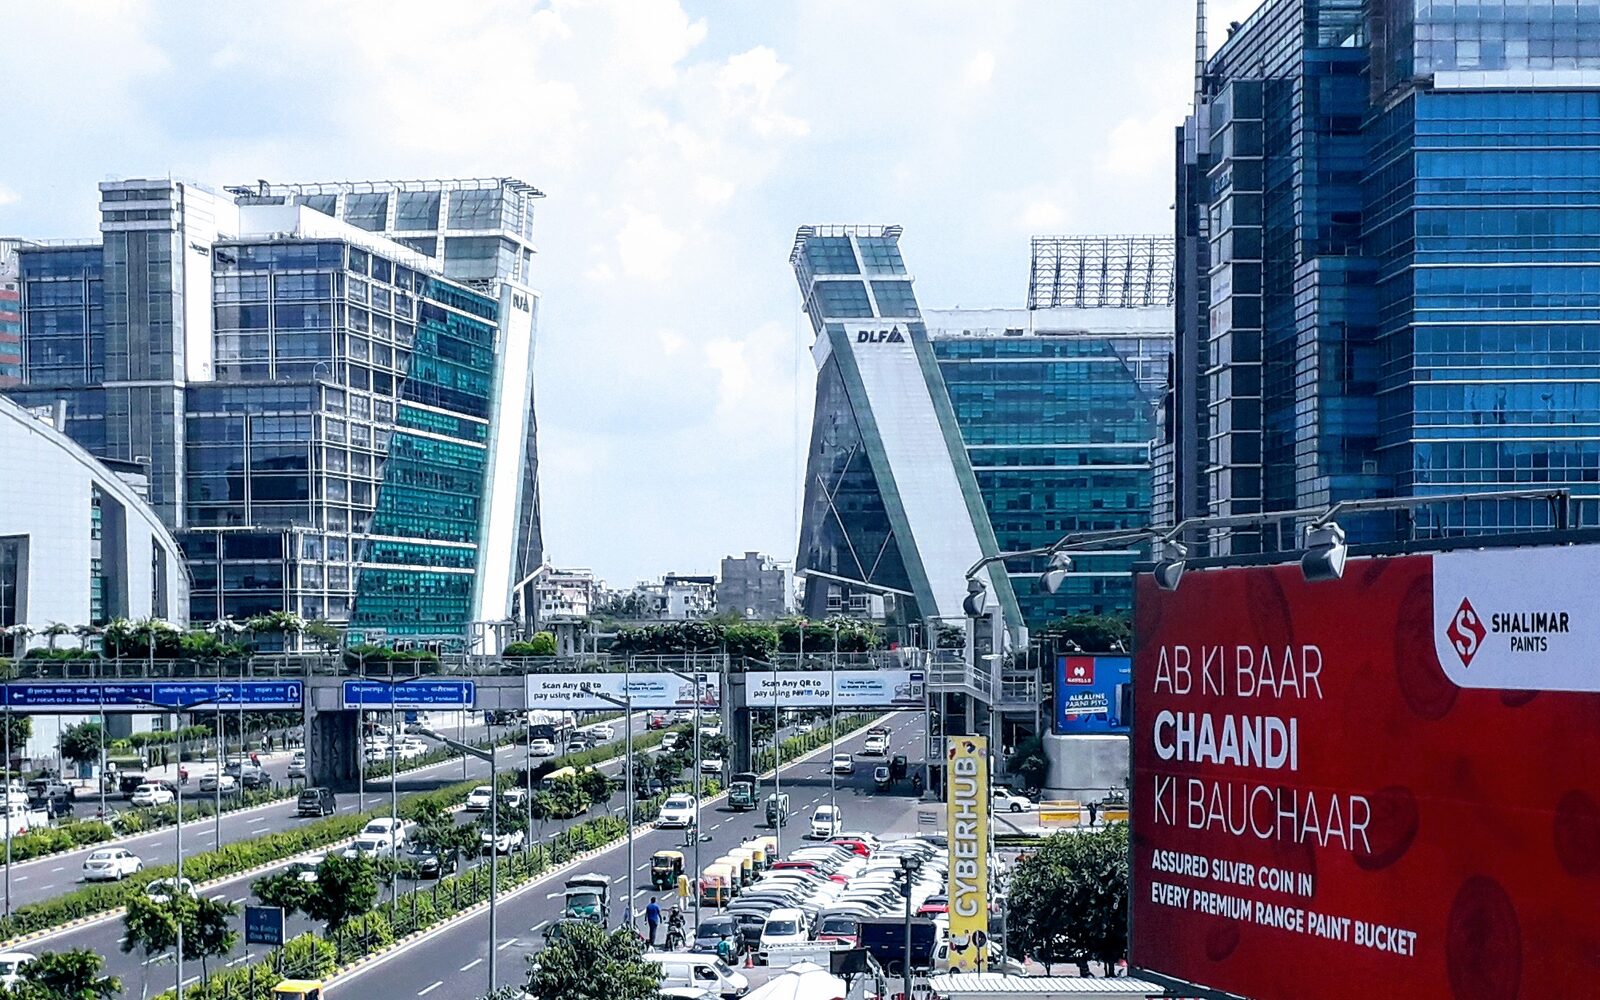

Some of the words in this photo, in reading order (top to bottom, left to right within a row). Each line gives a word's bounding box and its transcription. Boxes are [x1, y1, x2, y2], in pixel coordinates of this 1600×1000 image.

[857, 330, 888, 343] DLF
[1491, 612, 1570, 633] SHALIMAR
[1510, 636, 1548, 652] PAINTS
[1153, 645, 1192, 695] AB
[1201, 645, 1225, 696] KI
[1236, 644, 1323, 700] BAAR
[562, 682, 578, 691] Any
[753, 691, 768, 699] pay
[814, 690, 830, 698] App
[782, 680, 798, 689] Any
[799, 679, 811, 688] QR
[534, 692, 549, 700] pay
[549, 692, 570, 700] using
[1153, 710, 1298, 771] CHAANDI
[1154, 775, 1177, 826] KI
[1187, 778, 1371, 854] BAUCHAAR
[954, 757, 979, 917] CYBERHUB
[1152, 849, 1209, 879] ASSURED
[1212, 859, 1255, 887] SILVER
[1258, 866, 1294, 893] COIN
[1298, 872, 1313, 897] IN
[1151, 882, 1190, 909] EVERY
[1192, 889, 1252, 922] PREMIUM
[1255, 901, 1304, 933] RANGE
[1307, 911, 1351, 942] PAINT
[1354, 921, 1417, 957] BUCKET
